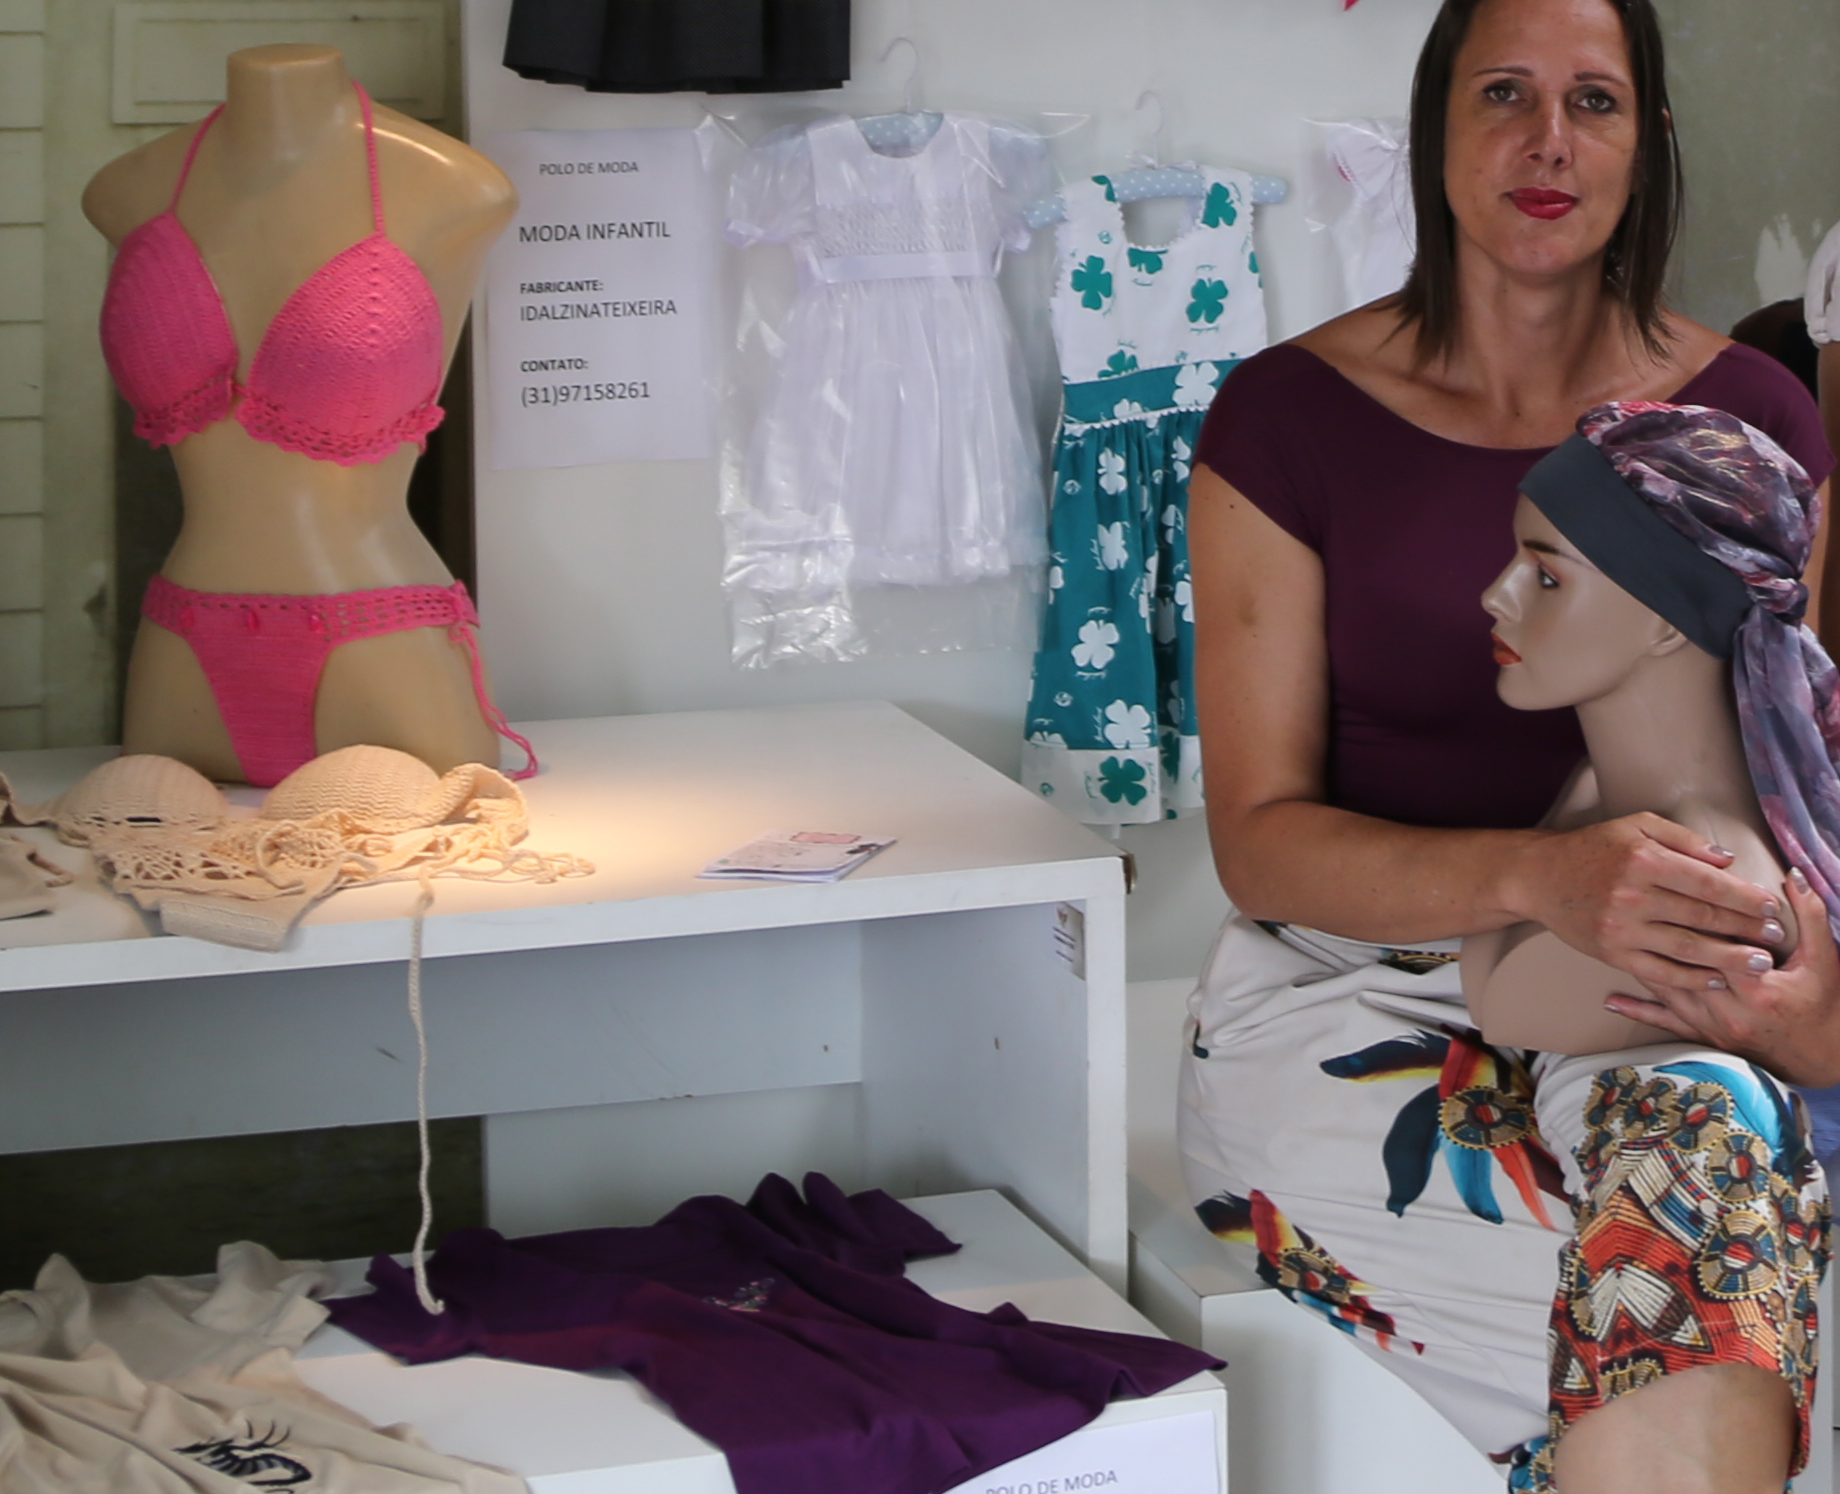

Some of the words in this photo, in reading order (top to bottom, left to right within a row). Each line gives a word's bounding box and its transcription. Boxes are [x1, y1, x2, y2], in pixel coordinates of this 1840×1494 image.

[539, 163, 573, 176] POLO
[577, 162, 594, 175] DE
[597, 161, 639, 175] MODA
[519, 224, 581, 244] MODA
[586, 221, 671, 241] INFANTIL
[520, 279, 604, 295] FABRICANTE:
[520, 299, 677, 322] IDALZINATEIXEIRA
[520, 358, 589, 373] CONTATO:
[520, 381, 651, 408] (31)97158261
[1037, 1480, 1059, 1494] DE
[1064, 1470, 1118, 1491] MODA
